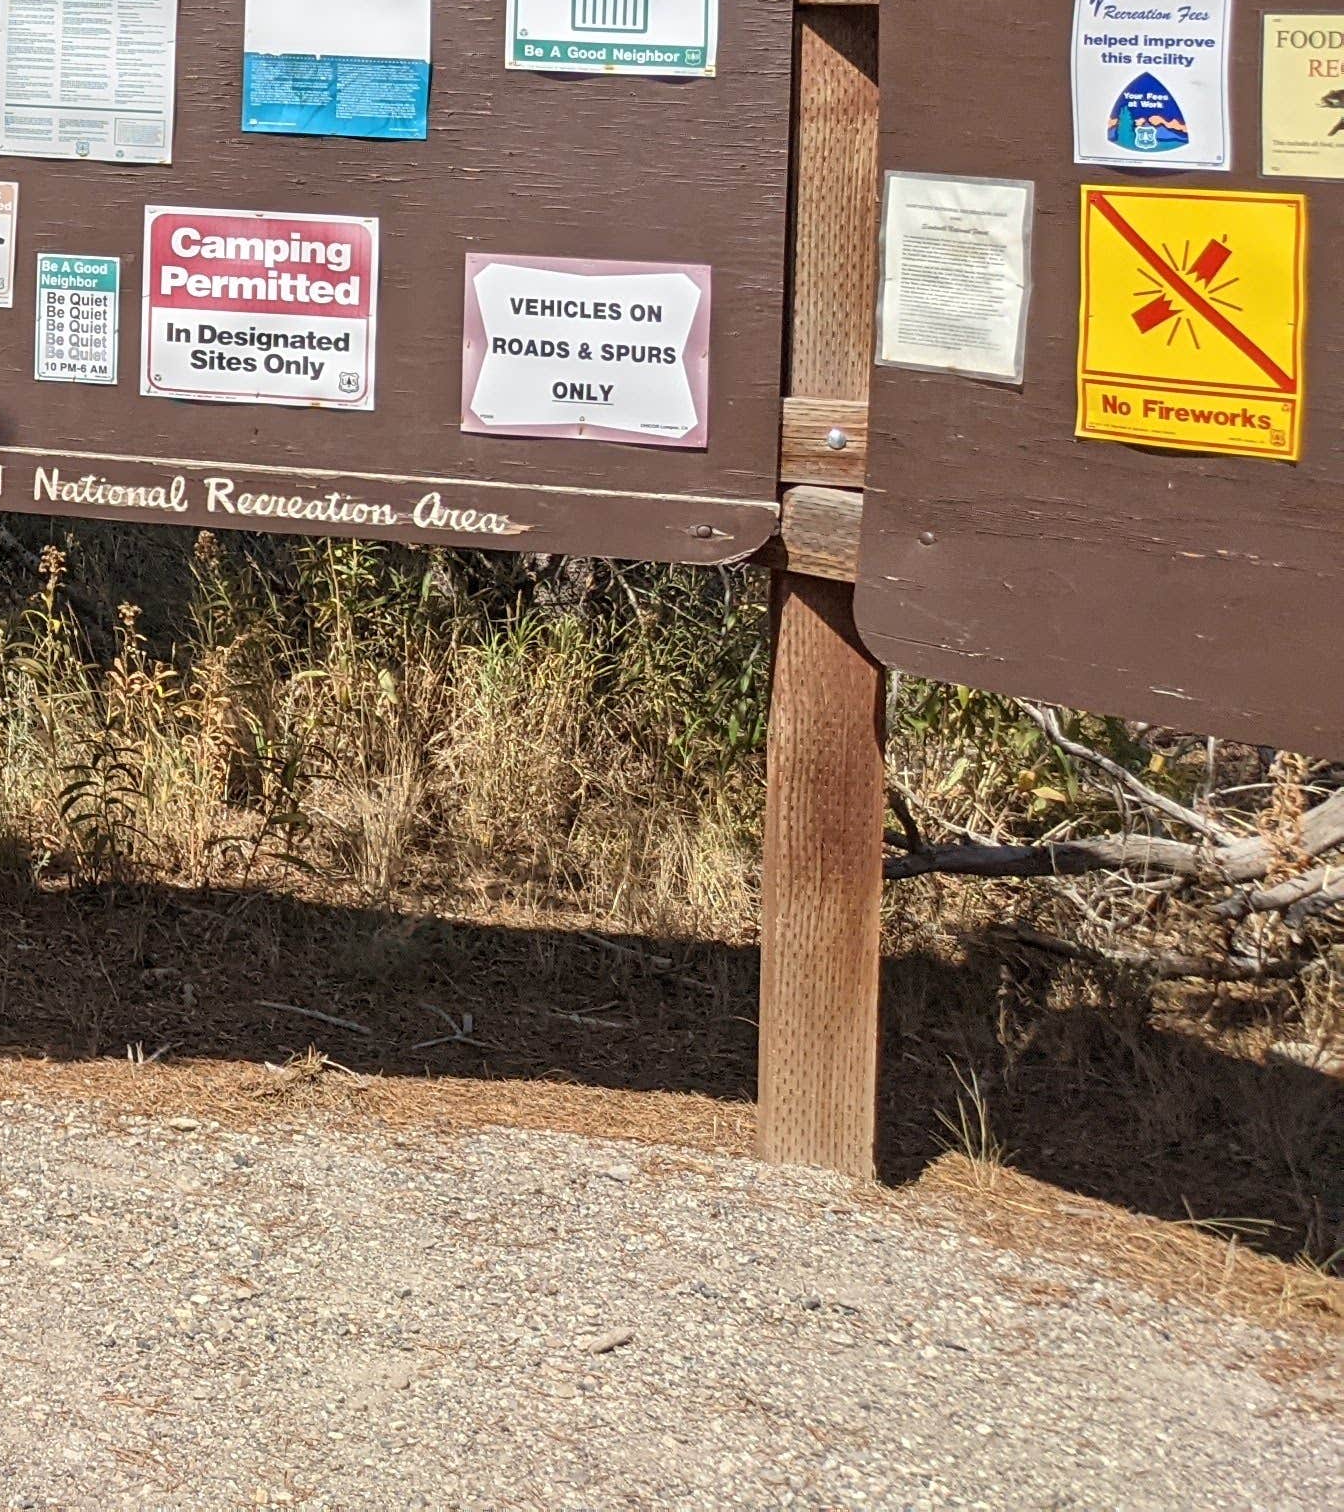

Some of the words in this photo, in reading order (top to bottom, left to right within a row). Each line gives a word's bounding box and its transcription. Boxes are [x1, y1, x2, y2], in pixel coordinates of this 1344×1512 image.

[1103, 5, 1171, 20] Recreation
[1178, 6, 1209, 23] Fees
[1084, 34, 1138, 47] helped
[1144, 35, 1215, 48] improve
[1277, 31, 1342, 49] FOOD
[524, 45, 544, 57] Be
[550, 46, 561, 57] A
[567, 47, 606, 60] Good
[613, 49, 680, 64] Neighbor
[1102, 52, 1131, 64] this
[1136, 53, 1194, 67] facility
[1308, 59, 1344, 77] RE
[171, 227, 351, 271] Camping
[42, 261, 58, 272] Be
[61, 261, 71, 272] A
[74, 262, 108, 274] Good
[41, 274, 98, 288] Neighbor
[161, 265, 360, 306] Permitted
[47, 292, 65, 304] Be
[70, 293, 108, 307] Quiet
[47, 305, 65, 318] Be
[70, 306, 107, 321] Quiet
[510, 297, 622, 320] VEHICLES
[630, 304, 662, 322] ON
[46, 319, 64, 332] Be
[69, 320, 107, 334] Quiet
[46, 332, 64, 346] Be
[69, 334, 107, 348] Quiet
[167, 322, 191, 343] In
[198, 324, 350, 352] Designated
[46, 346, 64, 359] Be
[68, 347, 107, 361] Quiet
[492, 337, 570, 359] ROADS
[578, 342, 592, 360] &
[600, 344, 676, 365] SPURS
[45, 362, 56, 371] 10
[60, 363, 87, 373] PM-6
[90, 365, 108, 374] AM
[190, 350, 257, 372] Sites
[264, 354, 325, 380] Only
[552, 382, 614, 402] ONLY
[1102, 394, 1131, 416] No
[1143, 399, 1271, 431] Fireworks
[34, 467, 188, 512] National
[204, 477, 397, 524] Recreation
[413, 491, 509, 534] Area
